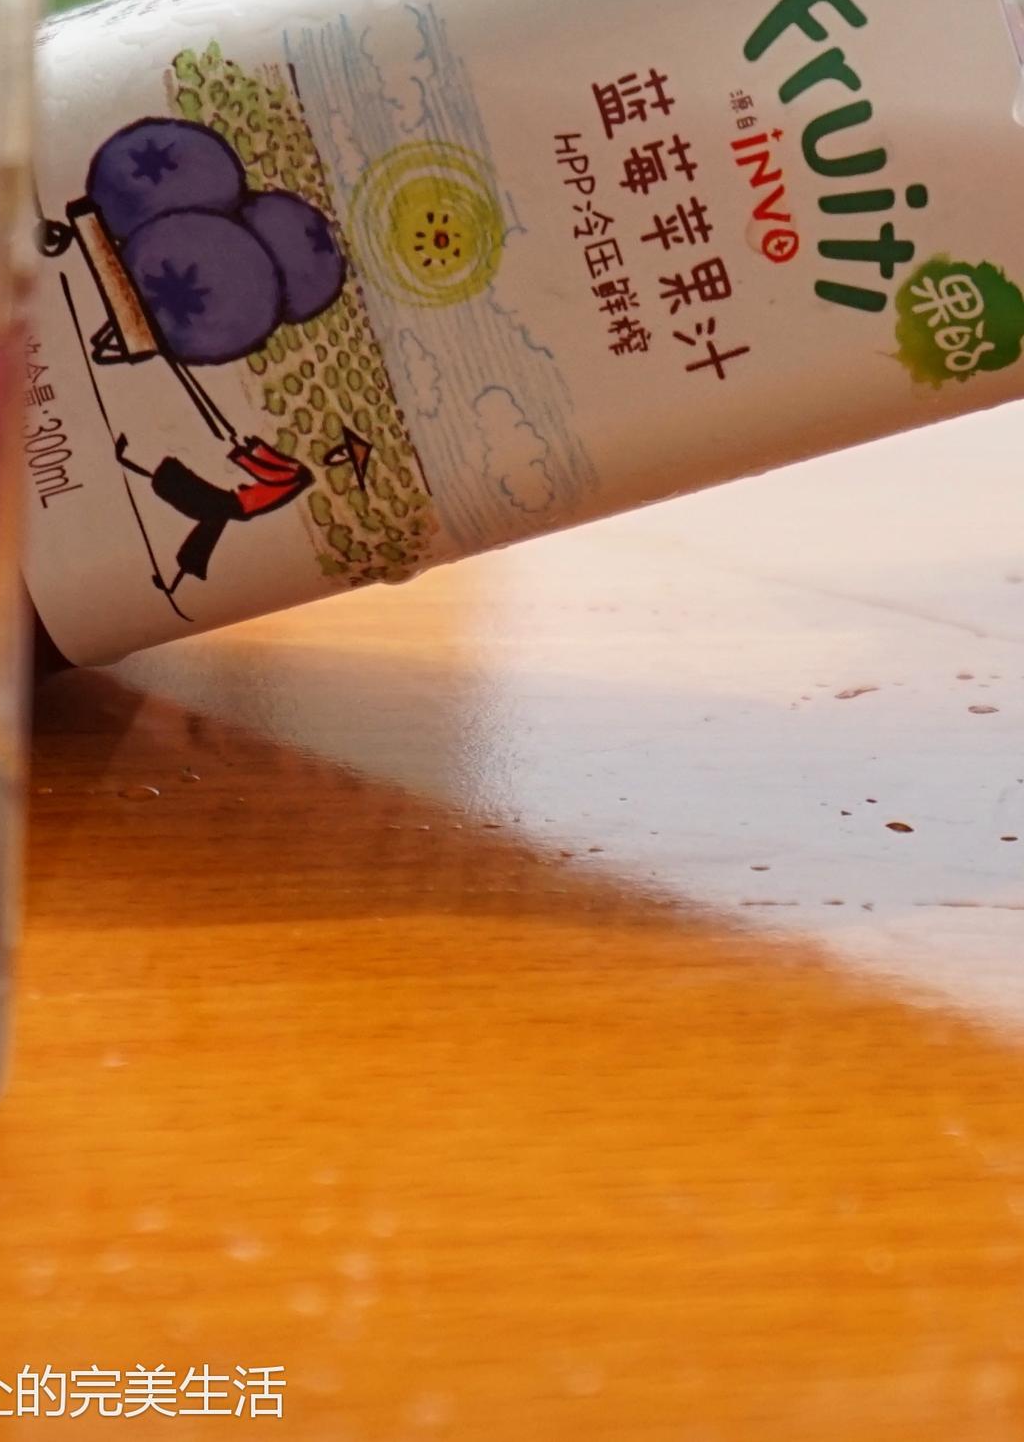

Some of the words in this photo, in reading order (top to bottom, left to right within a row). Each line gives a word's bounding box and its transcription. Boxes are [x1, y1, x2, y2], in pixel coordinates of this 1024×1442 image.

[590, 67, 751, 381] 蓝莓苹果汁
